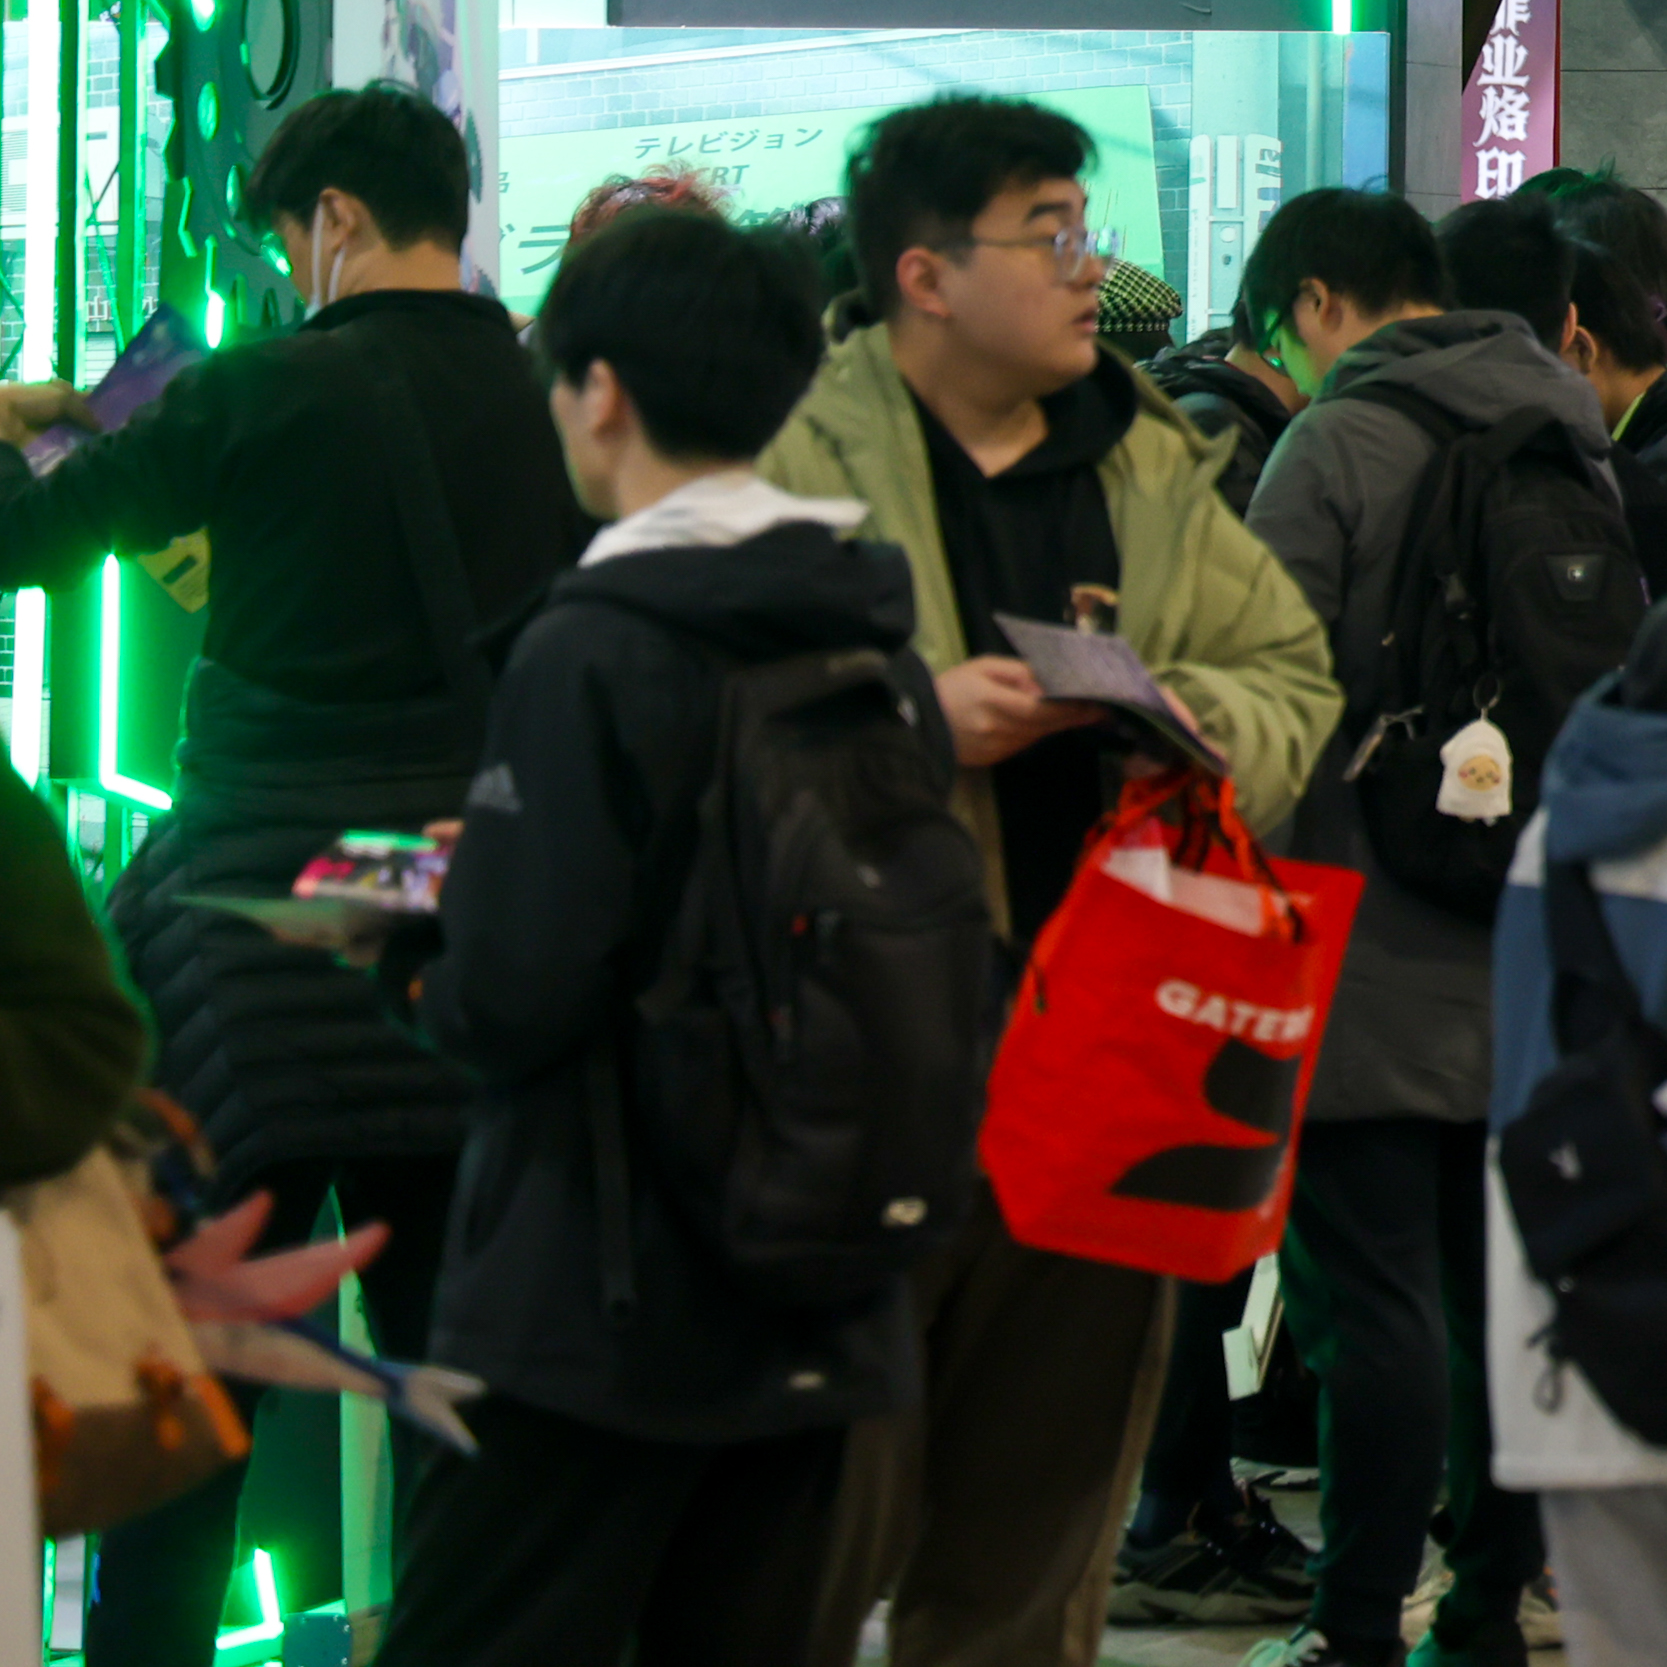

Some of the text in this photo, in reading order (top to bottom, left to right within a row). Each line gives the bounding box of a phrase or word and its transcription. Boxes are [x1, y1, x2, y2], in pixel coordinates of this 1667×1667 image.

[635, 128, 824, 160] テレビジョン
